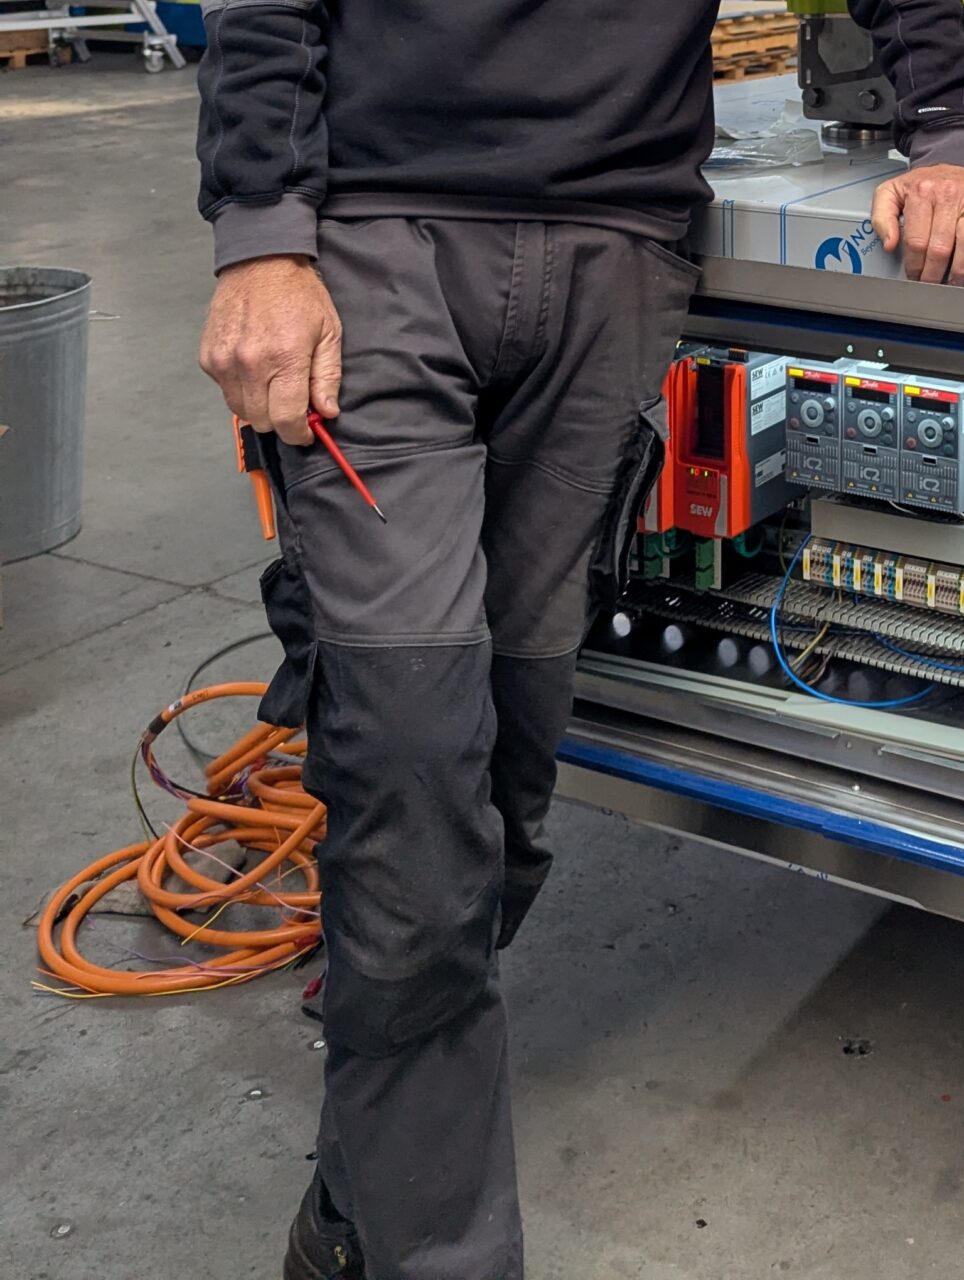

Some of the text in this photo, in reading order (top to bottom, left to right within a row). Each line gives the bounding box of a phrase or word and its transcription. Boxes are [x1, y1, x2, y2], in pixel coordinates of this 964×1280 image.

[802, 457, 823, 471] iC2
[859, 467, 880, 482] iC2
[919, 477, 941, 493] iC2
[690, 503, 713, 517] SEW
